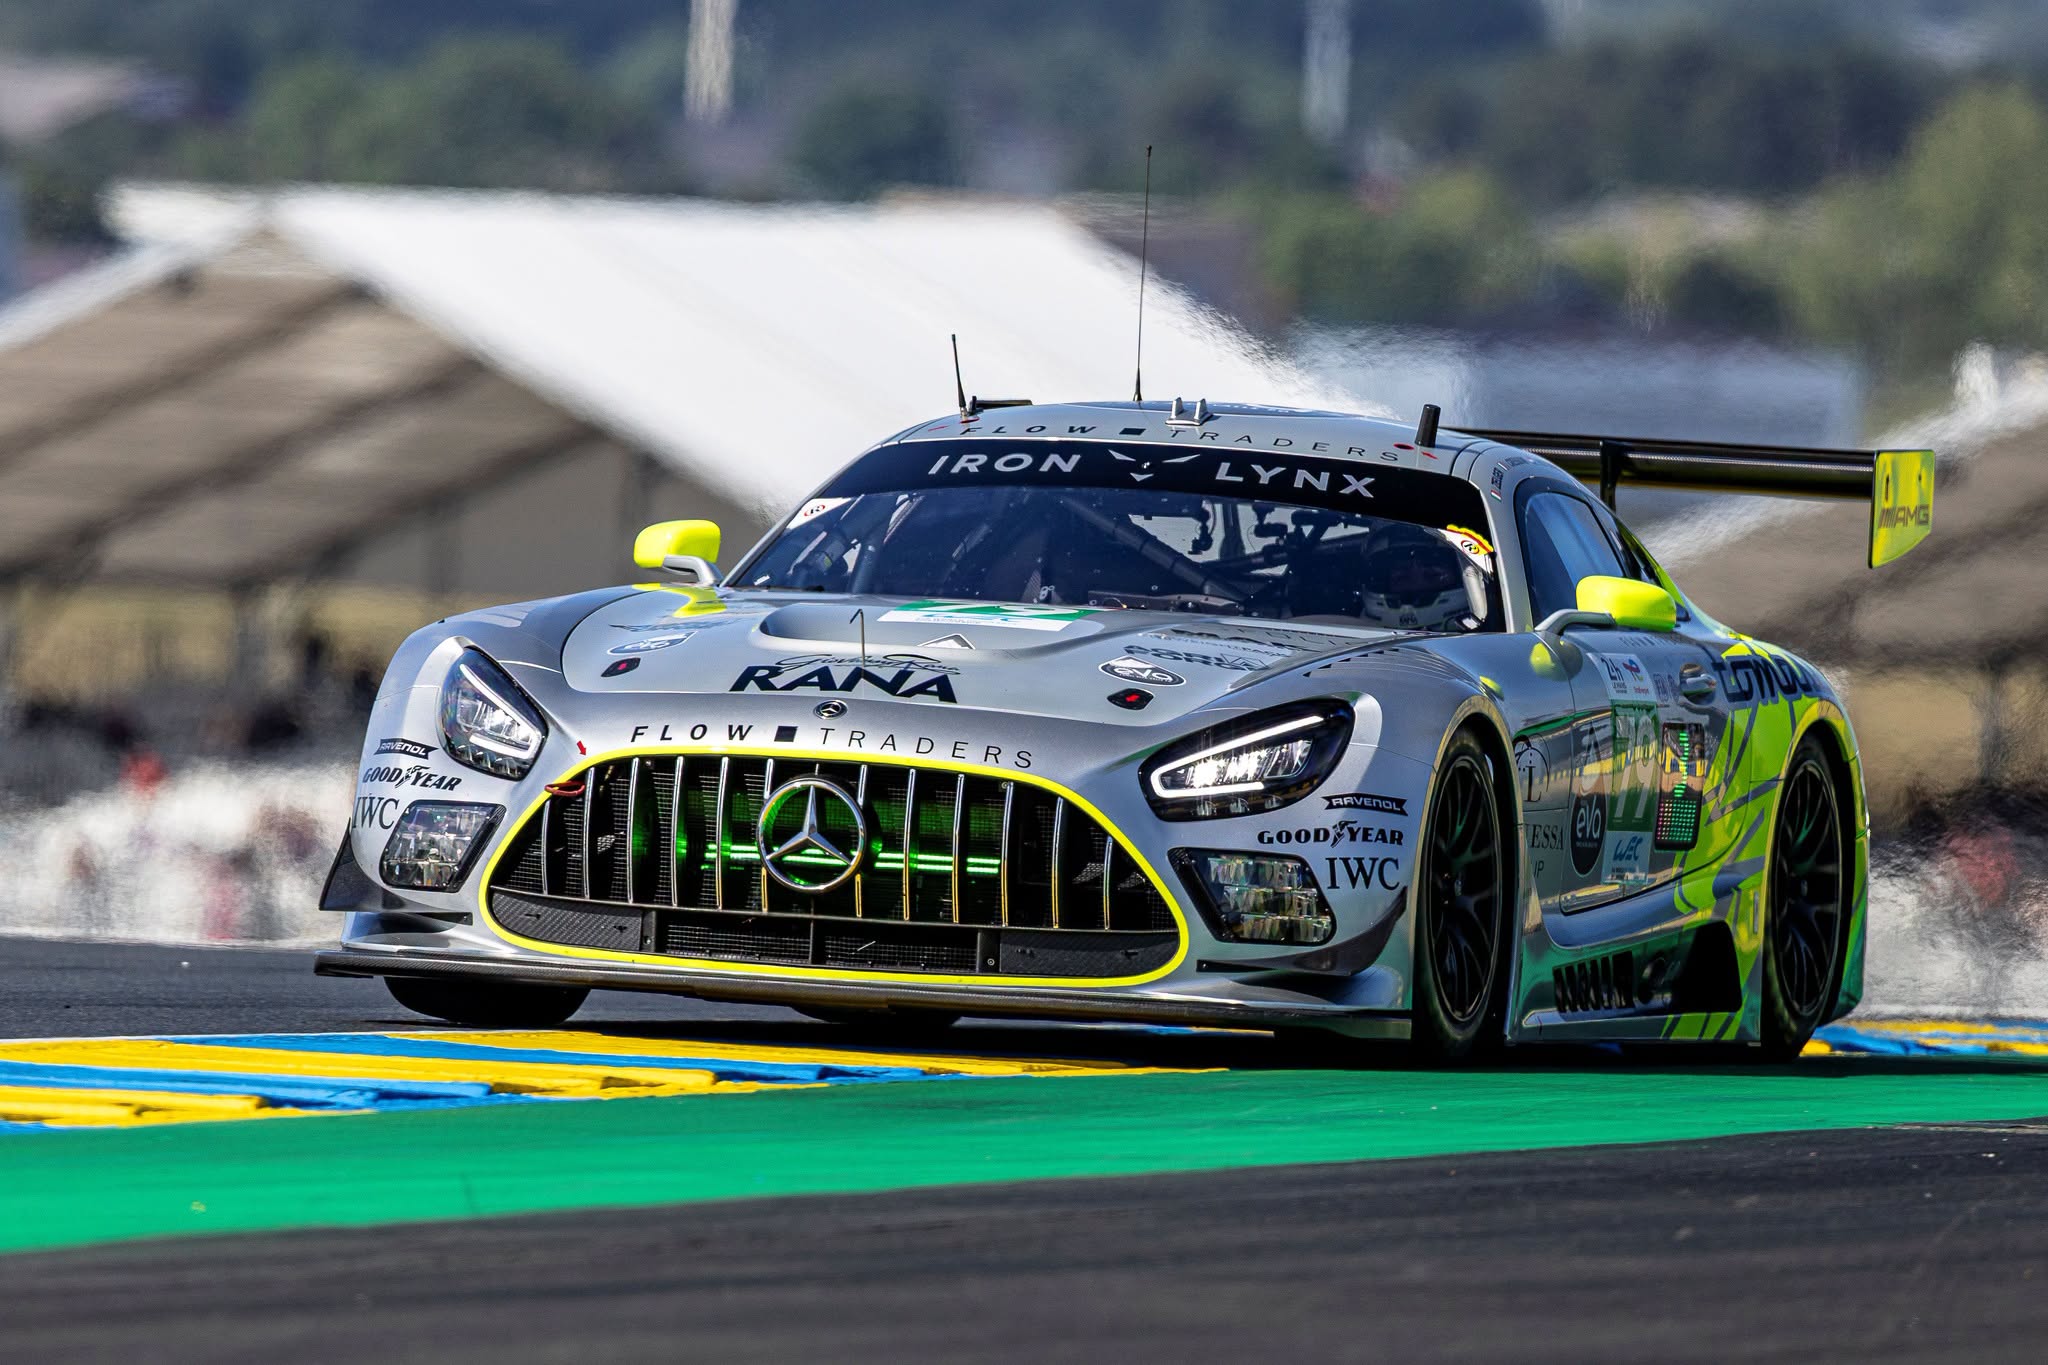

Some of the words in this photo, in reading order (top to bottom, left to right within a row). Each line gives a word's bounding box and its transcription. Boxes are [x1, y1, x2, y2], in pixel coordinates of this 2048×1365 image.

[961, 425, 1097, 435] FLOW
[1169, 429, 1399, 462] TRADERS
[928, 453, 1081, 475] IRON
[1215, 462, 1375, 498] LYNX
[729, 666, 957, 703] RANA
[380, 741, 427, 756] RAVENOL
[631, 724, 753, 743] FLOW
[819, 727, 1032, 769] TRADERS
[362, 766, 462, 791] GOODYEAR
[1614, 714, 1657, 818] 79
[352, 796, 399, 830] IWC
[1331, 798, 1401, 811] RAVENOL
[1257, 825, 1404, 847] GOODYEAR
[1325, 857, 1400, 891] IWC
